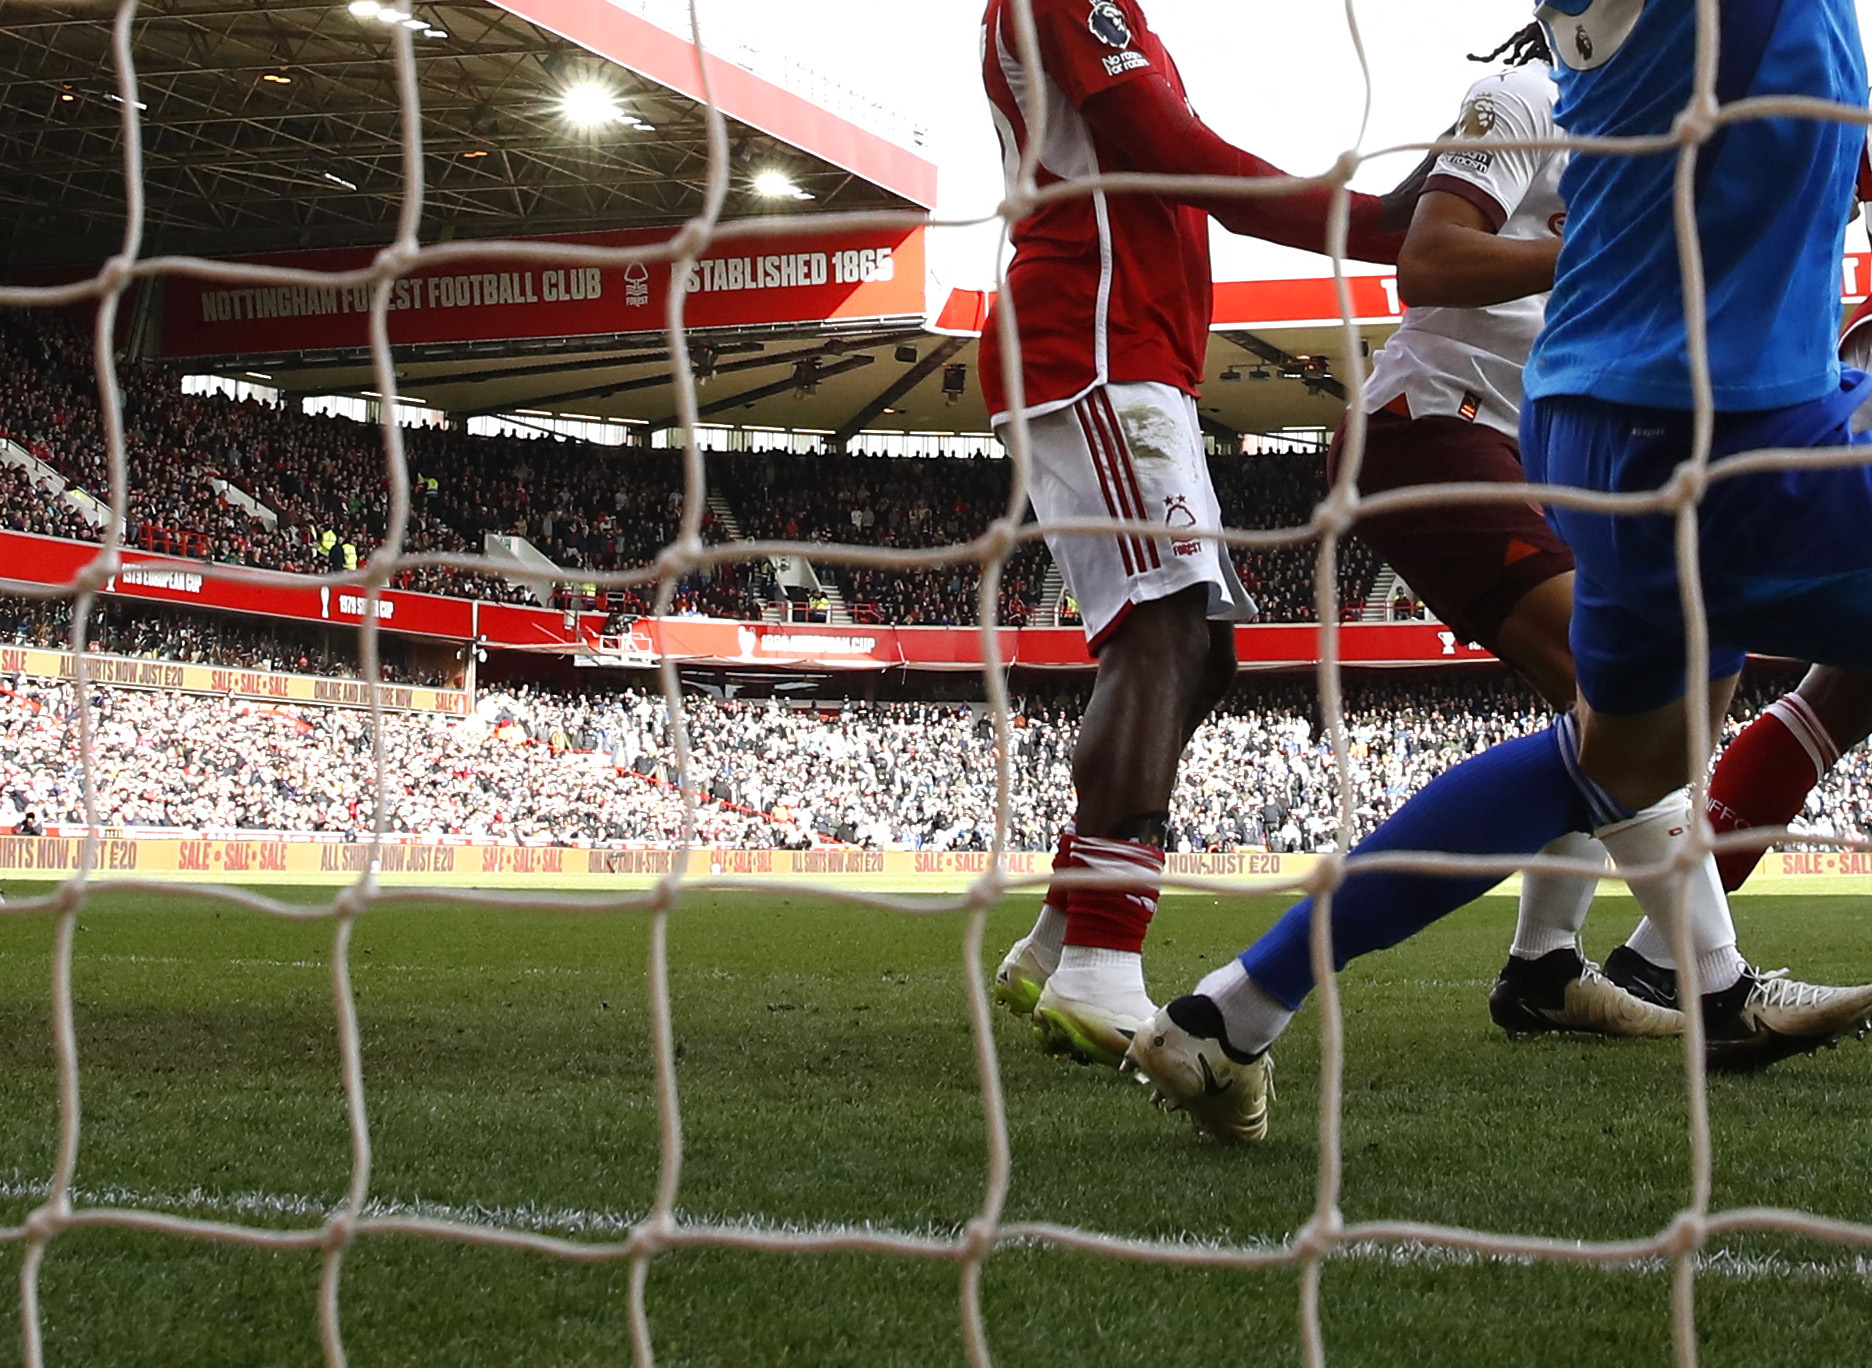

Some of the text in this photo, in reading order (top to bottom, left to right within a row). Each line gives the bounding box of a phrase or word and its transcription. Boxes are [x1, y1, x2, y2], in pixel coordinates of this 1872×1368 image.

[201, 285, 338, 322] NOTTINGHAM
[343, 278, 423, 313] FOEST
[428, 271, 538, 309] FOOTBALL
[542, 267, 602, 302] CLUB
[832, 247, 894, 283] 1865
[2, 649, 27, 672] SALE
[81, 658, 114, 682] HIRTS
[116, 662, 138, 683] NOW
[139, 663, 163, 685] JUST
[164, 666, 184, 687] £20
[211, 670, 289, 696] SALE SALE SALE
[37, 838, 69, 870] NOW
[109, 841, 137, 870] £20
[179, 841, 288, 871] SALE SALE SALE
[321, 844, 339, 871] ALL
[382, 845, 405, 872] NOW
[407, 846, 433, 872] JUST
[433, 845, 454, 872] £20
[513, 848, 536, 873] SALE
[914, 853, 944, 873] SALE
[955, 853, 985, 873] SALE
[1168, 854, 1281, 874] NOW JUST £20
[1782, 853, 1824, 875] SALE
